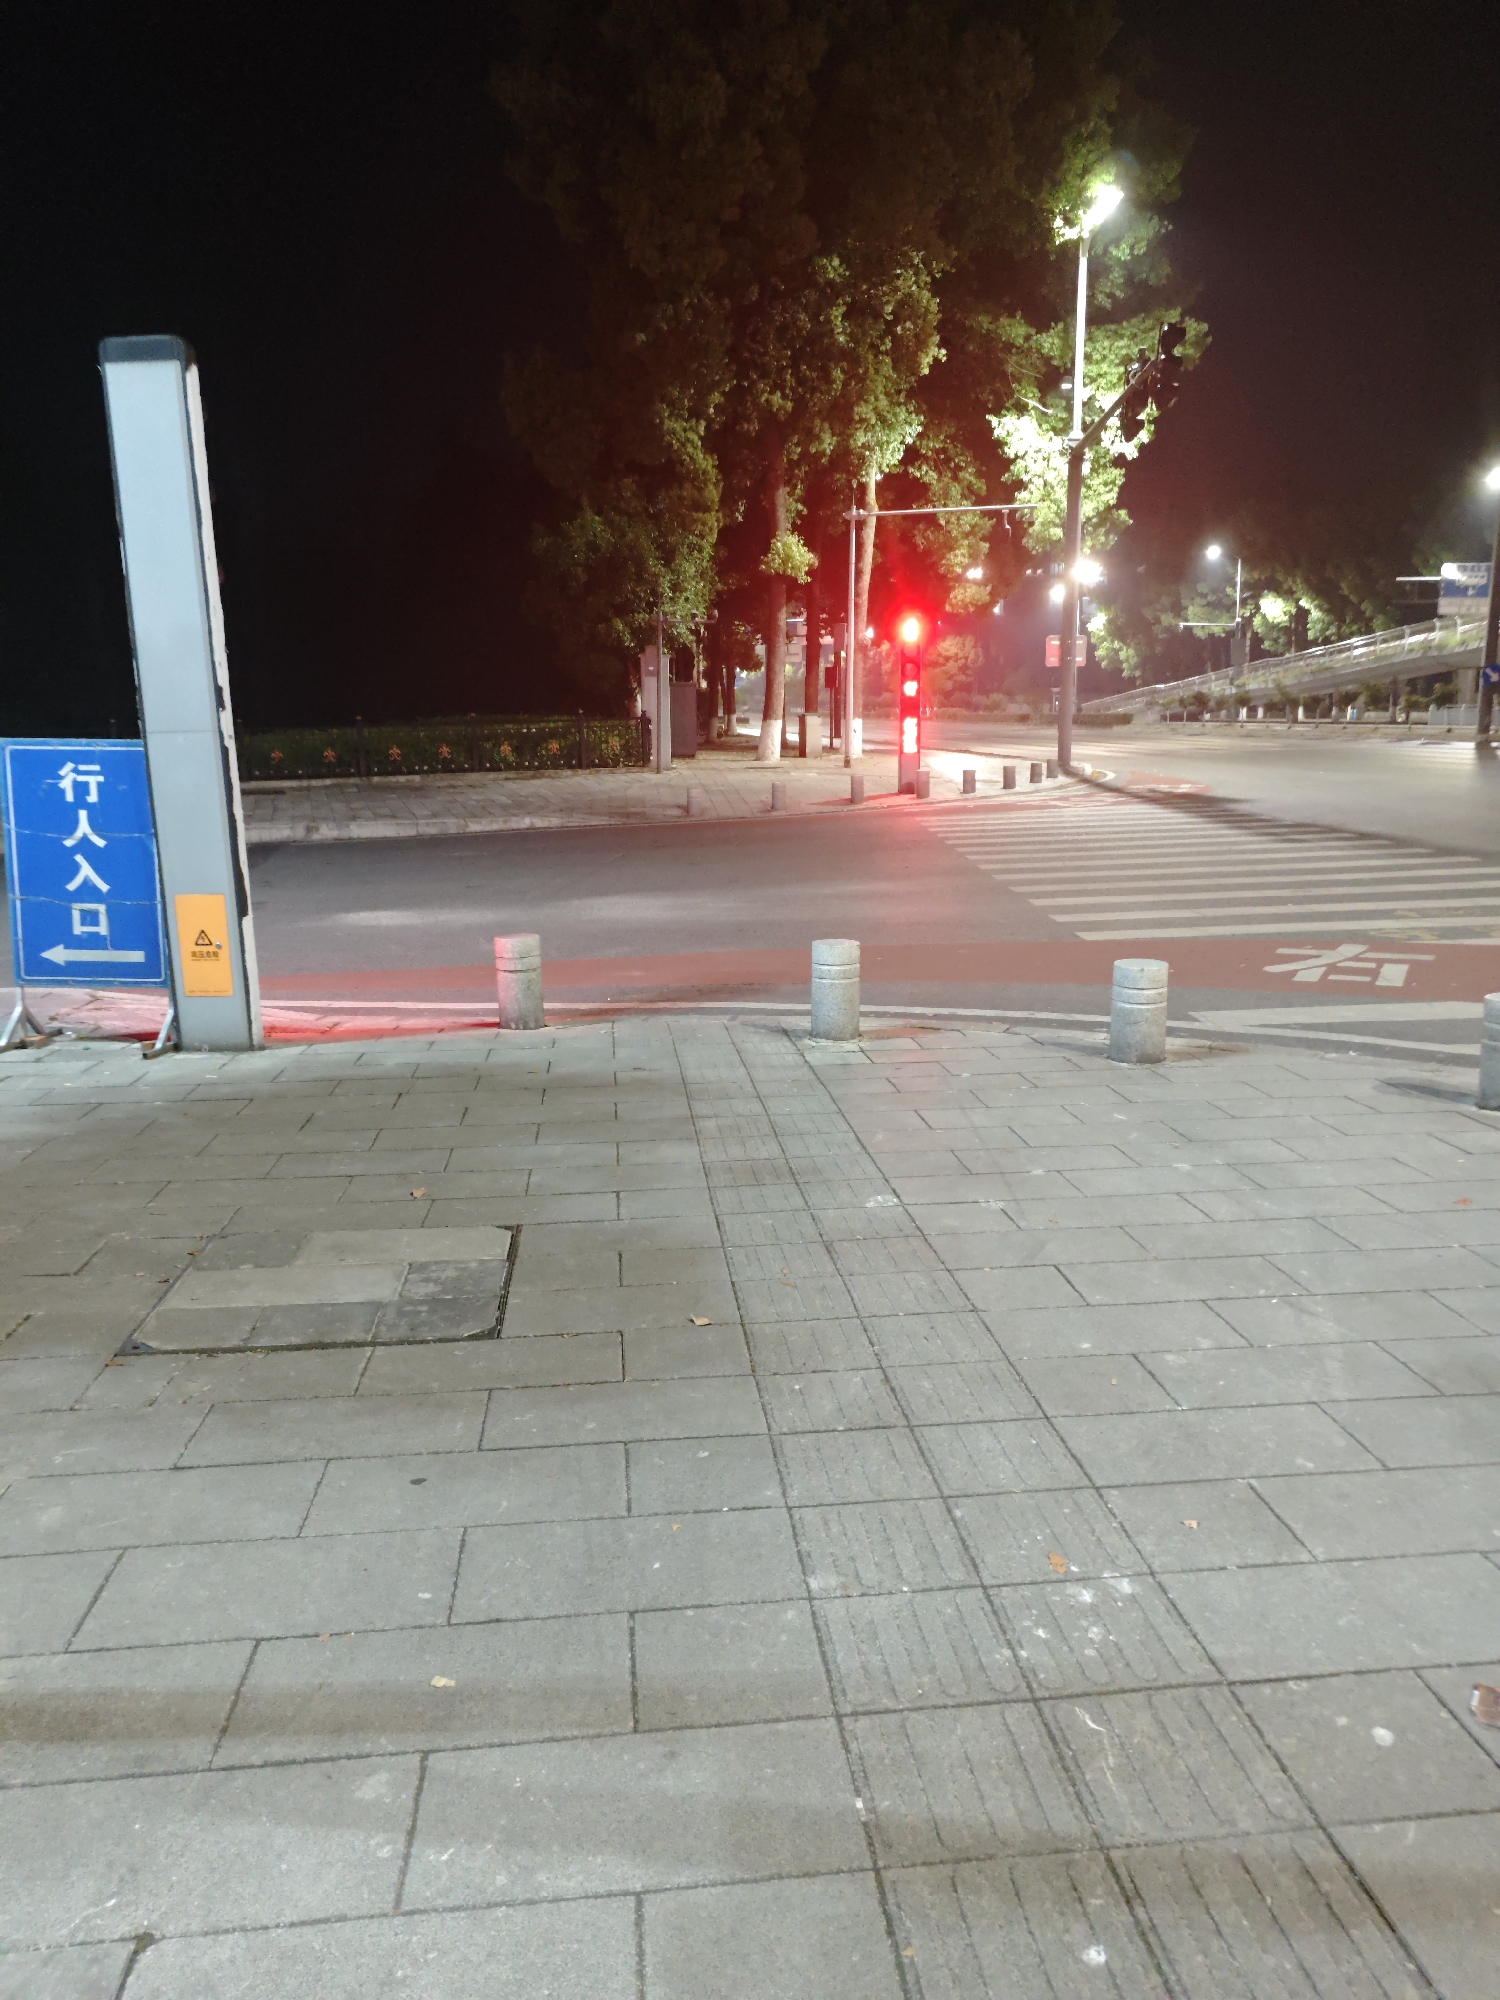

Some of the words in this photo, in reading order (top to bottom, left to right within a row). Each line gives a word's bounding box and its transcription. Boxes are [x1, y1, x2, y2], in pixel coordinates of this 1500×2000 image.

[58, 761, 111, 936] 行人入口
[1263, 943, 1437, 986] 右
